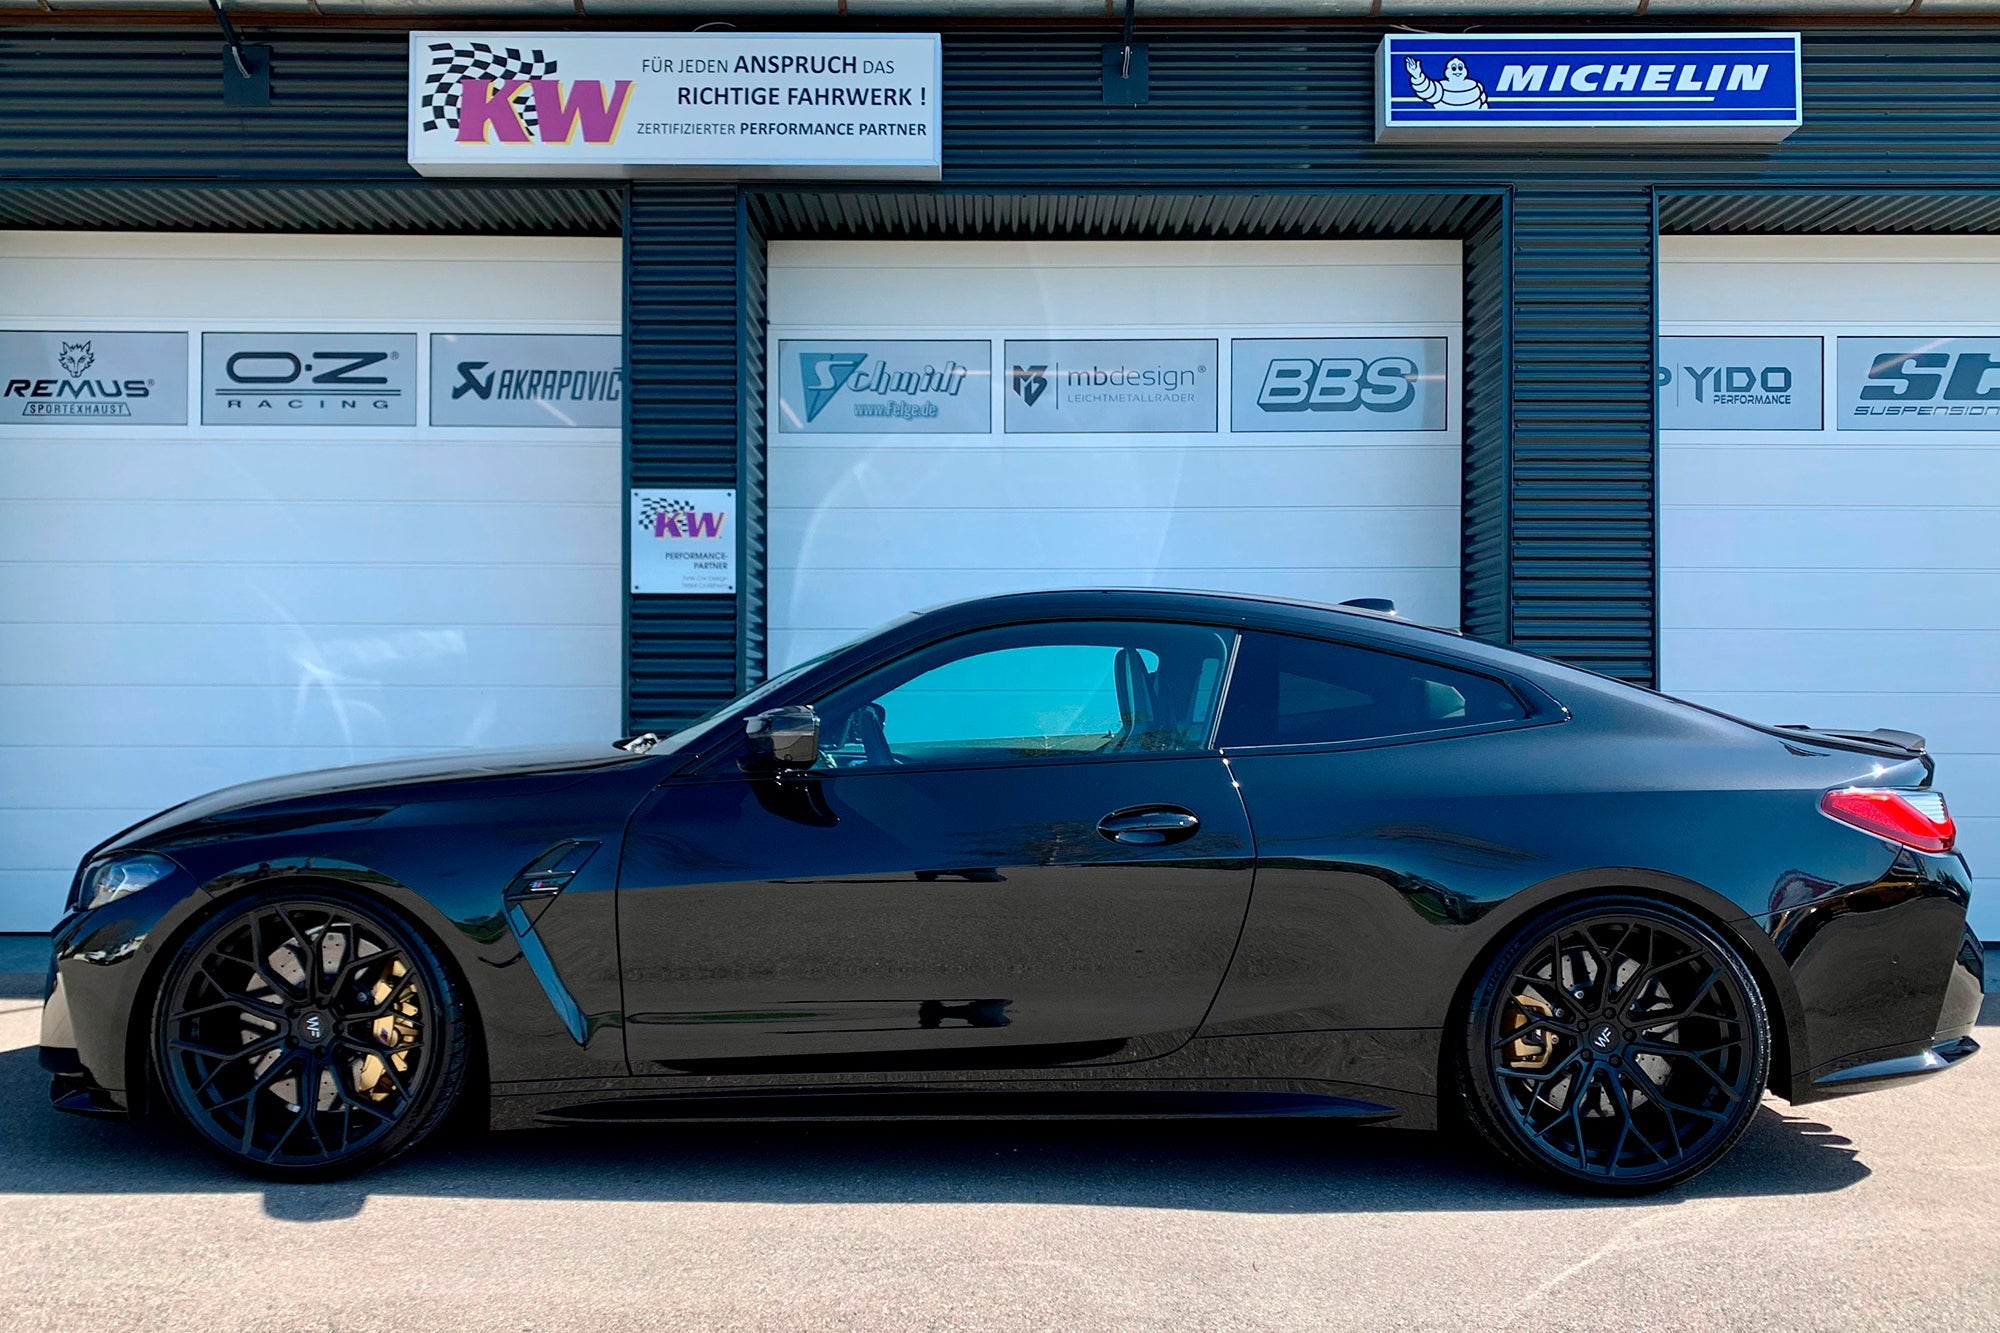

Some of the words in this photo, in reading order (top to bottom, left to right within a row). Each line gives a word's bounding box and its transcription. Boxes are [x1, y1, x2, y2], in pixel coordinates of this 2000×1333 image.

[642, 57, 675, 74] FÜR
[679, 59, 729, 74] JEDEN
[733, 55, 857, 74] ANSPRUCH
[863, 60, 895, 74] DAS
[1495, 64, 1770, 92] MICHELIN
[678, 87, 780, 106] RICHTIGE
[788, 87, 912, 106] FAHRWERK
[455, 79, 637, 145] KW
[637, 123, 736, 136] ZERTIFIZIERTER
[740, 123, 854, 136] PERFORMANCE
[859, 123, 927, 136] PARTNER
[1257, 357, 1418, 412] BBS
[1683, 366, 1792, 403] YIDO
[29, 402, 124, 415] SPORTEXHAUST
[227, 399, 388, 409] RACING
[1713, 395, 1792, 405] PERFORMANCE
[654, 512, 726, 539] KW
[694, 562, 728, 570] PARTNER
[1594, 1027, 1611, 1048] WF
